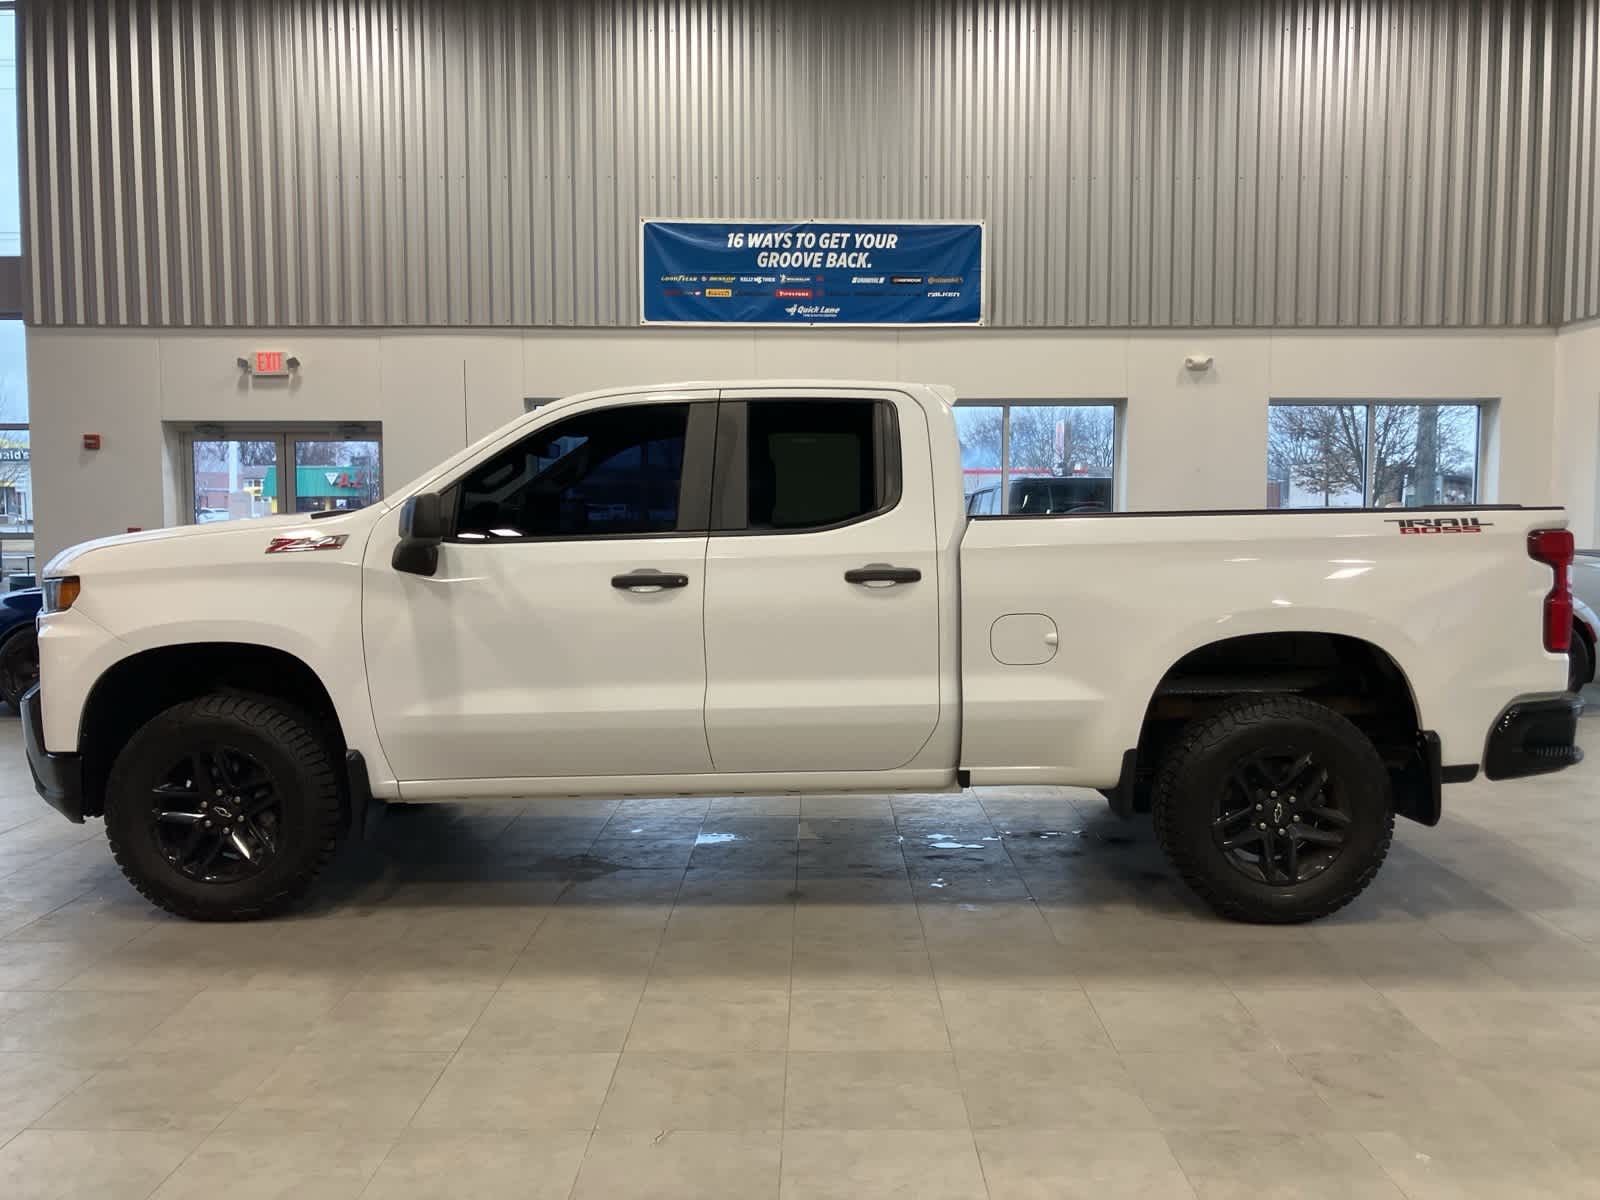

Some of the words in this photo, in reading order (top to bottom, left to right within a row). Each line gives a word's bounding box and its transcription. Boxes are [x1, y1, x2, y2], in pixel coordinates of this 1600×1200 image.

[727, 232, 744, 248] 16
[748, 232, 793, 249] WAYS
[795, 233, 816, 249] TO
[818, 233, 851, 249] GET
[854, 233, 898, 249] YOUR
[757, 252, 823, 268] GROOVE
[825, 252, 872, 269] BACK.
[797, 305, 820, 314] Quick
[819, 306, 840, 314] Lane
[257, 351, 281, 372] EXIT
[1384, 517, 1494, 528] TRAIL
[1400, 526, 1481, 534] BOSS
